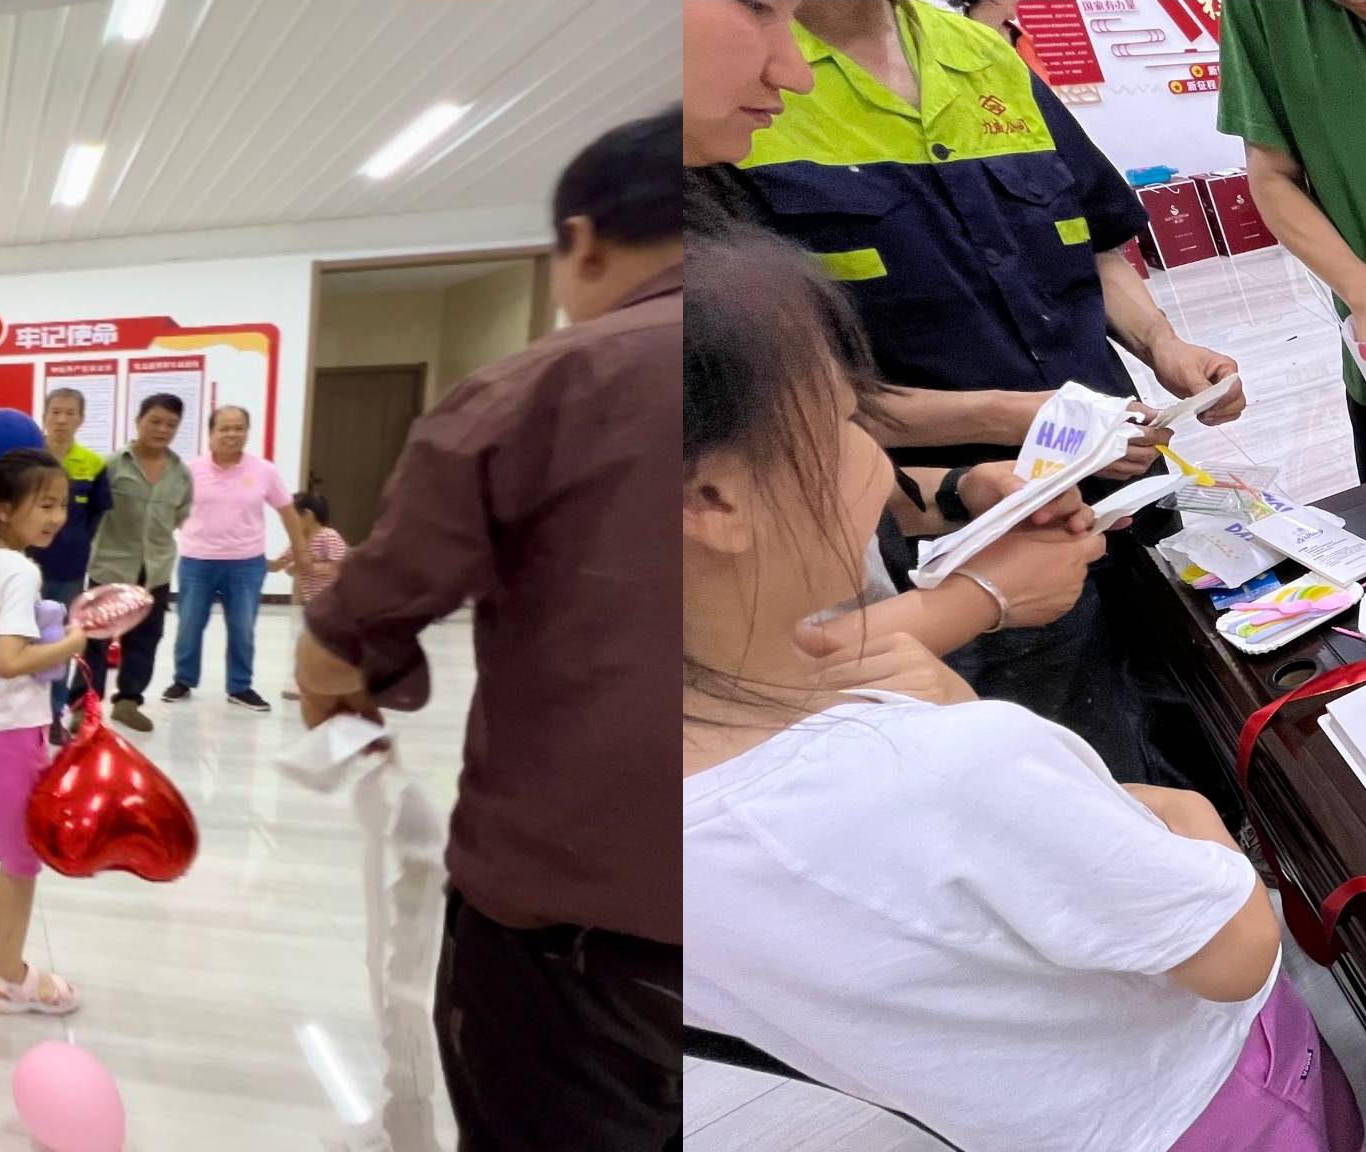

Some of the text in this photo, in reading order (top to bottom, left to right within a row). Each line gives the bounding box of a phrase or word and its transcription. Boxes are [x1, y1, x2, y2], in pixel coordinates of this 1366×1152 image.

[1186, 79, 1218, 92] 新征程
[15, 323, 120, 350] 牢记使命
